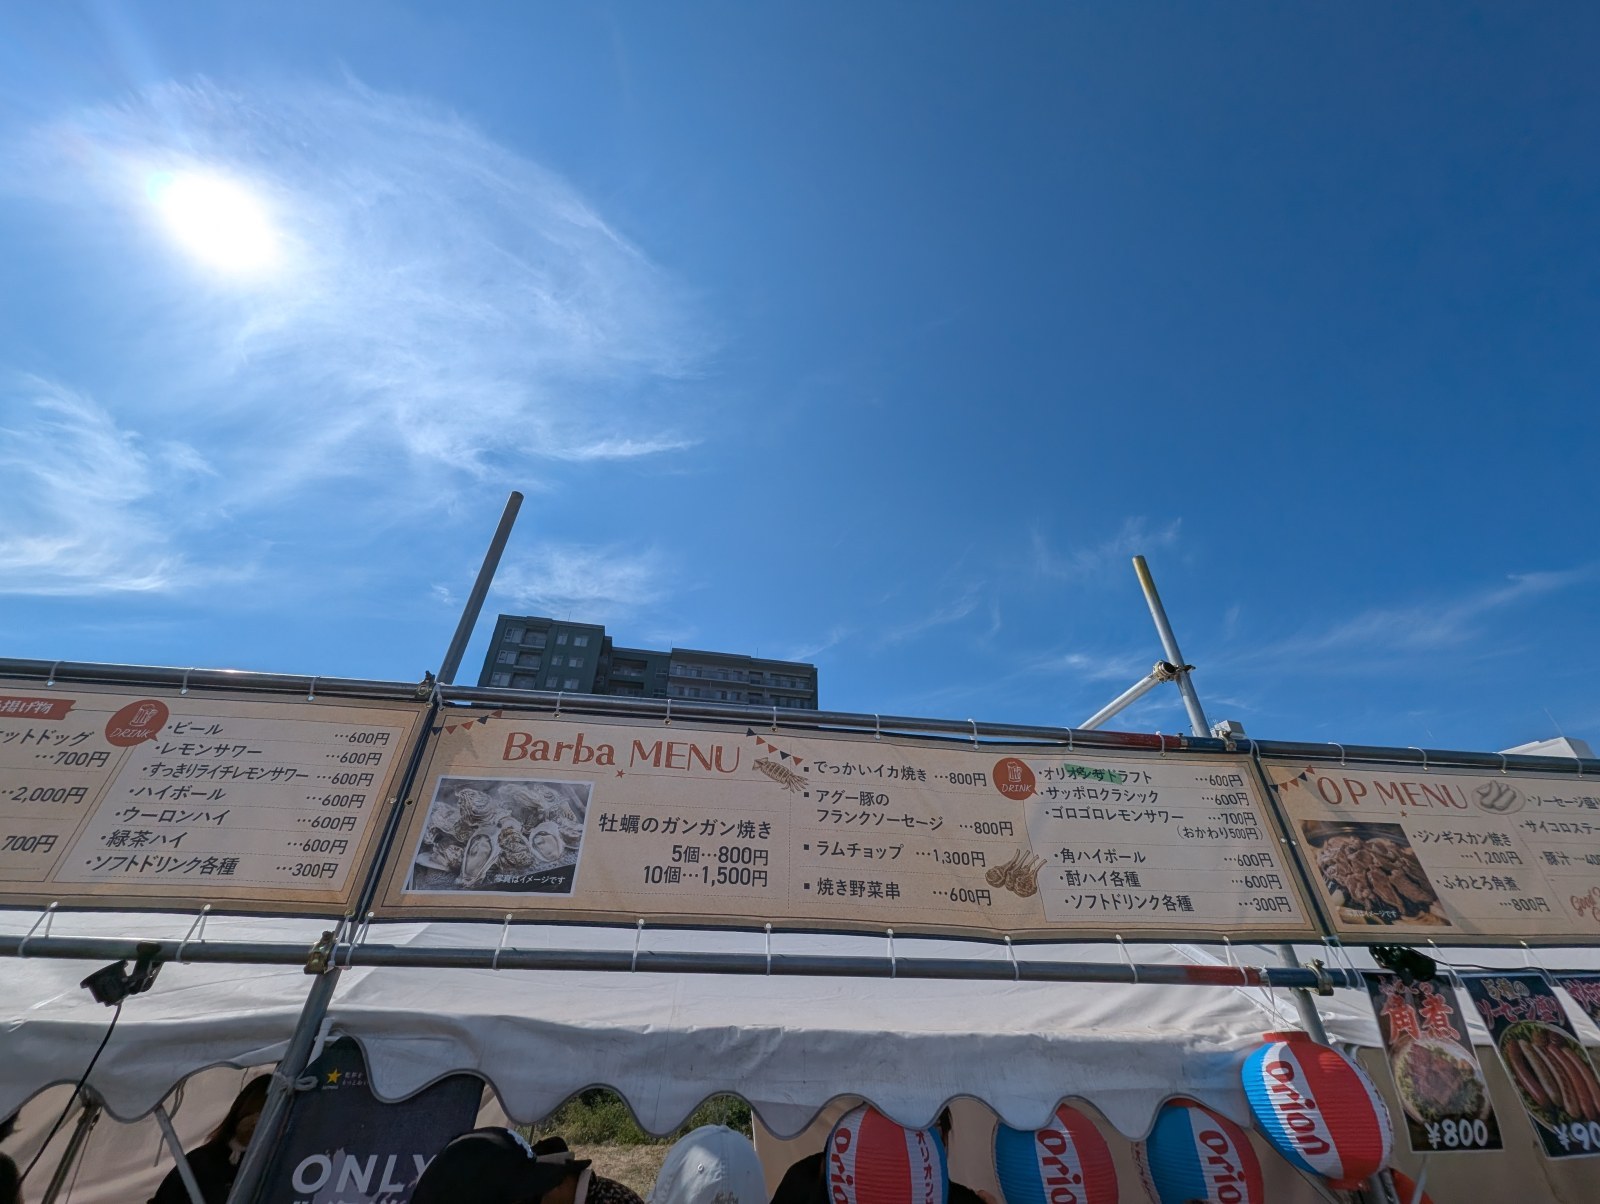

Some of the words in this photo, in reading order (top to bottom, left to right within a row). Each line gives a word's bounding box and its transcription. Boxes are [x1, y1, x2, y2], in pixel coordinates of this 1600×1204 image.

[0, 700, 53, 714] 揚げ物
[0, 728, 95, 746] ットドッグ
[110, 727, 153, 738] DRINK
[503, 732, 615, 766] Barba
[630, 740, 740, 773] MENU
[1001, 783, 1032, 792] DRINK
[1317, 776, 1367, 805] OP
[1373, 780, 1468, 809] MENU
